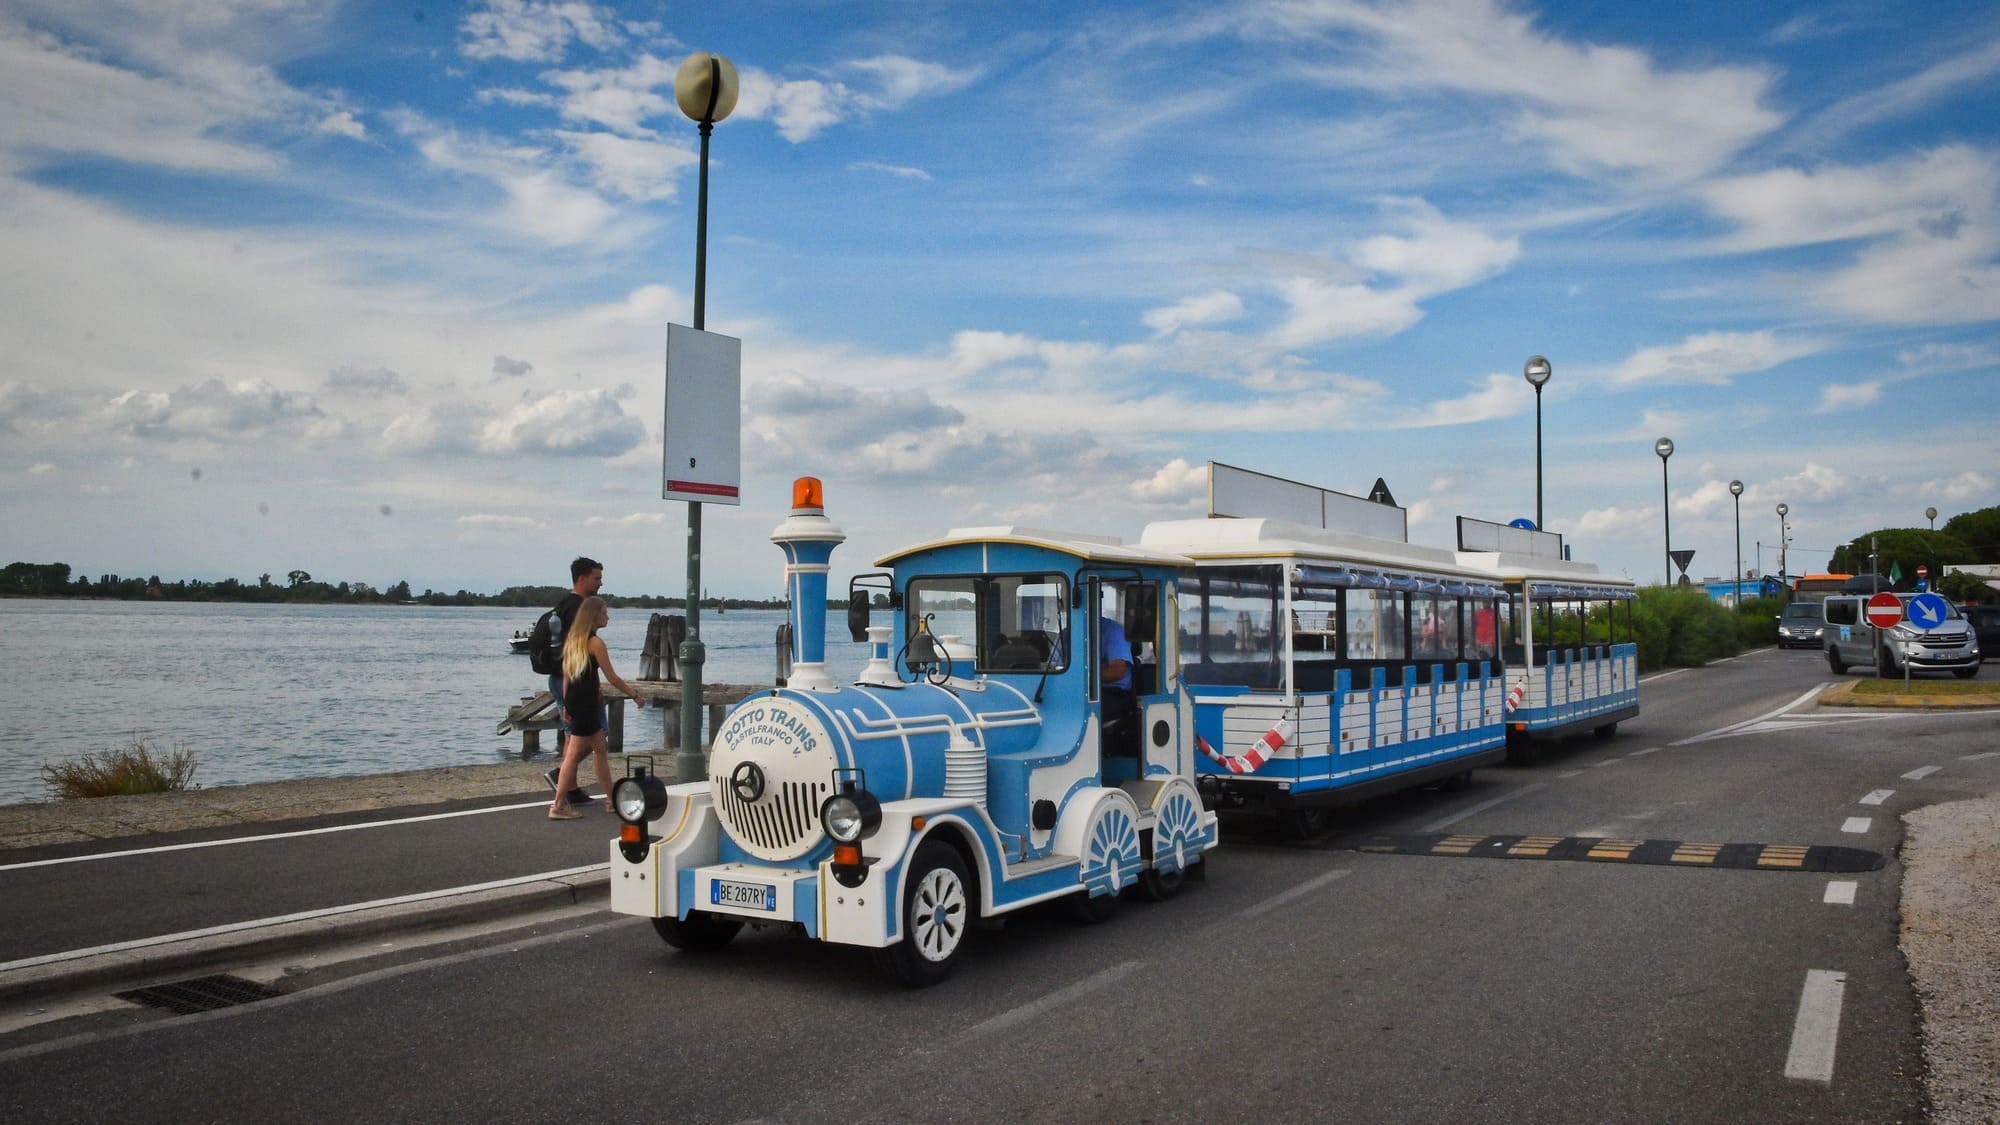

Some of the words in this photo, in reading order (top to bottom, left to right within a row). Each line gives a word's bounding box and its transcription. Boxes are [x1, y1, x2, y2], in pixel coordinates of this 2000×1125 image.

[725, 708, 764, 743] DOTTO
[770, 708, 816, 751] TRAINS
[730, 725, 792, 751] CASTELFRANCO
[752, 736, 775, 746] ITALY
[720, 884, 732, 901] BE
[735, 886, 766, 904] 287RY
